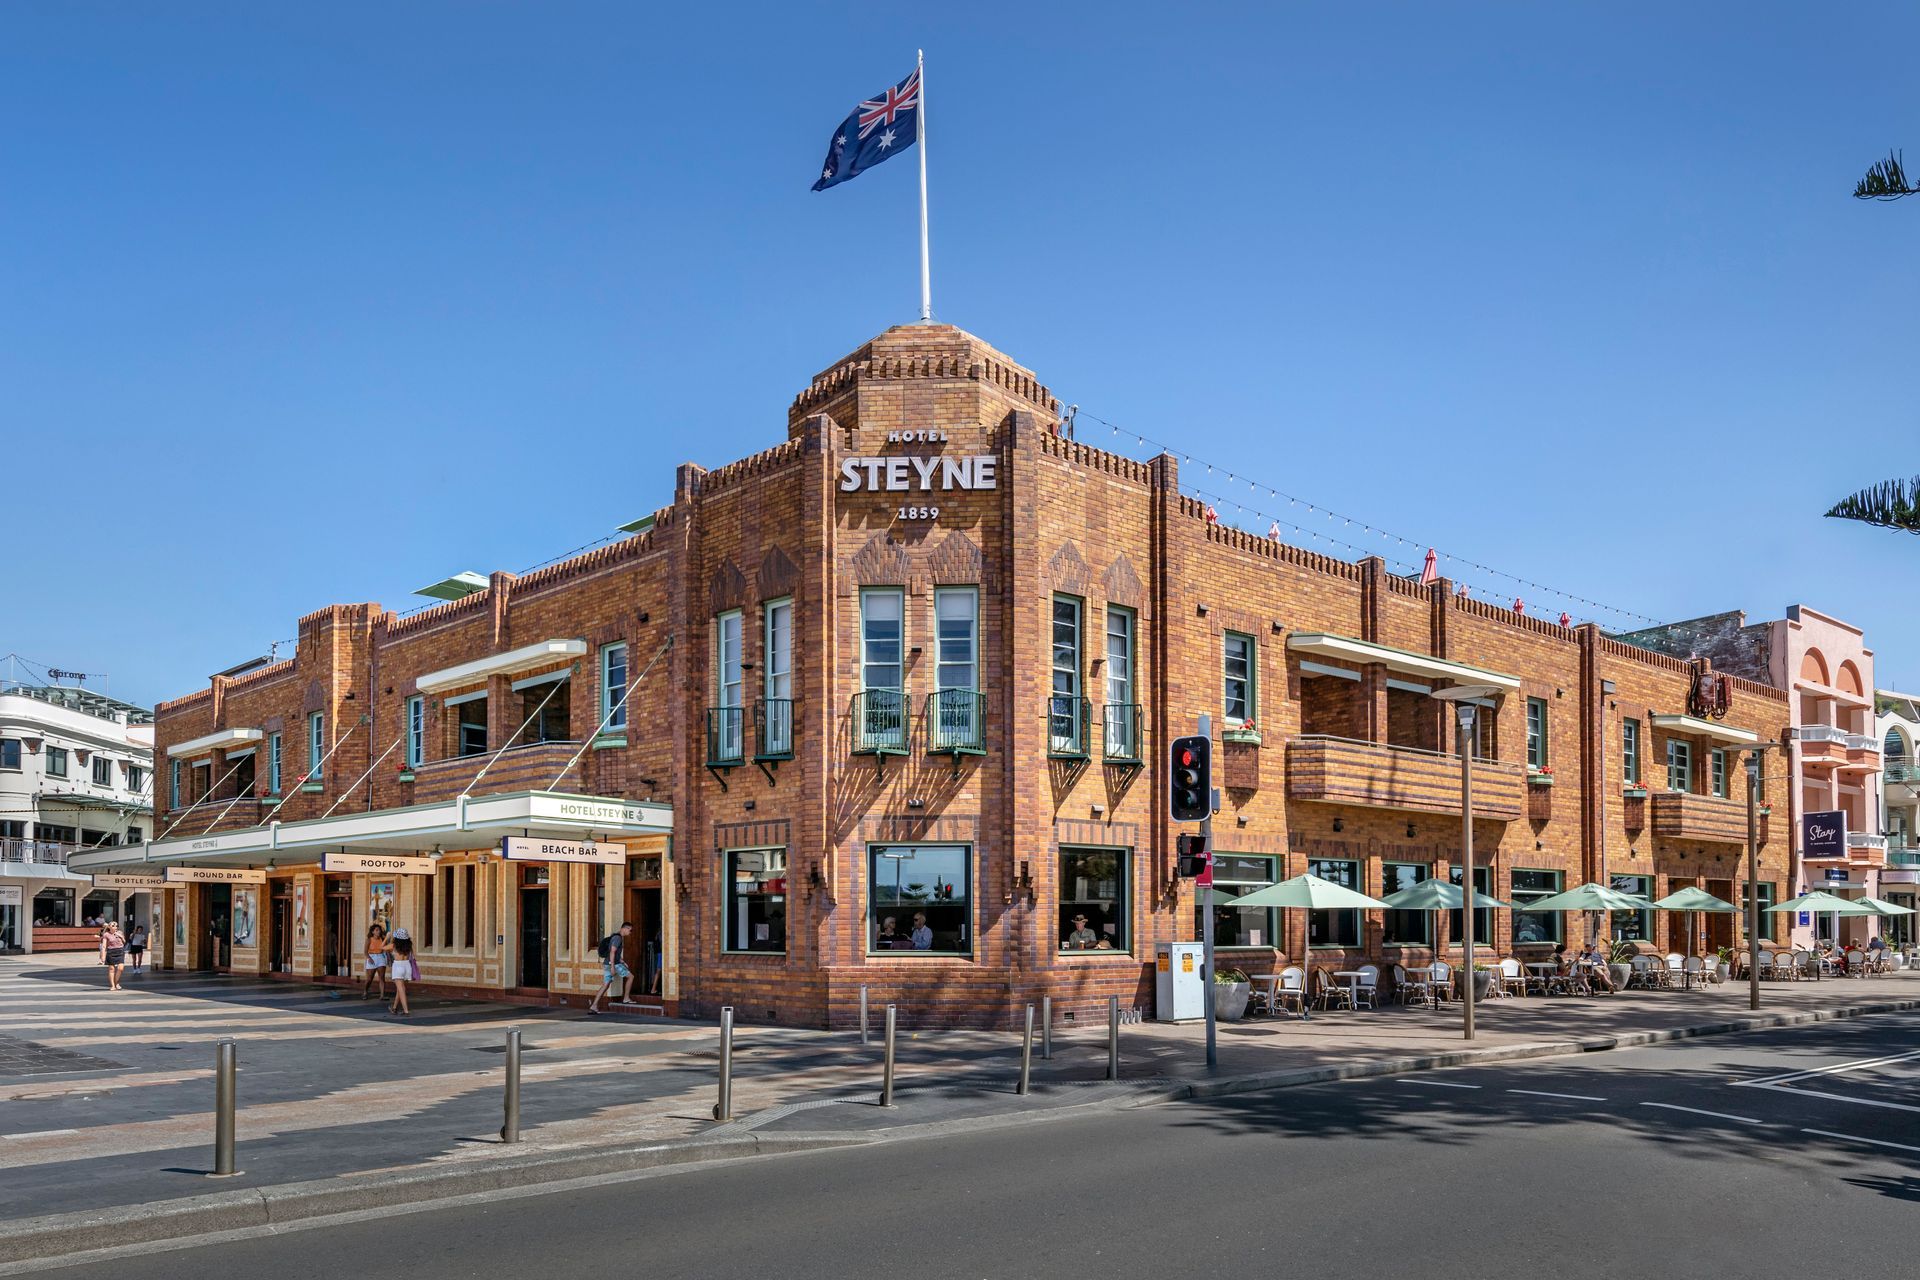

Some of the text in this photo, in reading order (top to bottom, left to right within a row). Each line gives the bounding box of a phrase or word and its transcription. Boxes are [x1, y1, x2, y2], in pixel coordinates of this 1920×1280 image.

[889, 429, 948, 442] HOTEL
[840, 455, 997, 492] STEYNE
[898, 507, 940, 520] 1859
[48, 668, 87, 680] Corona
[560, 804, 634, 820] HOTEL STEYNE
[1809, 824, 1836, 841] Stay
[541, 845, 598, 856] BEACH BAR
[360, 859, 406, 868] ROOFTOP
